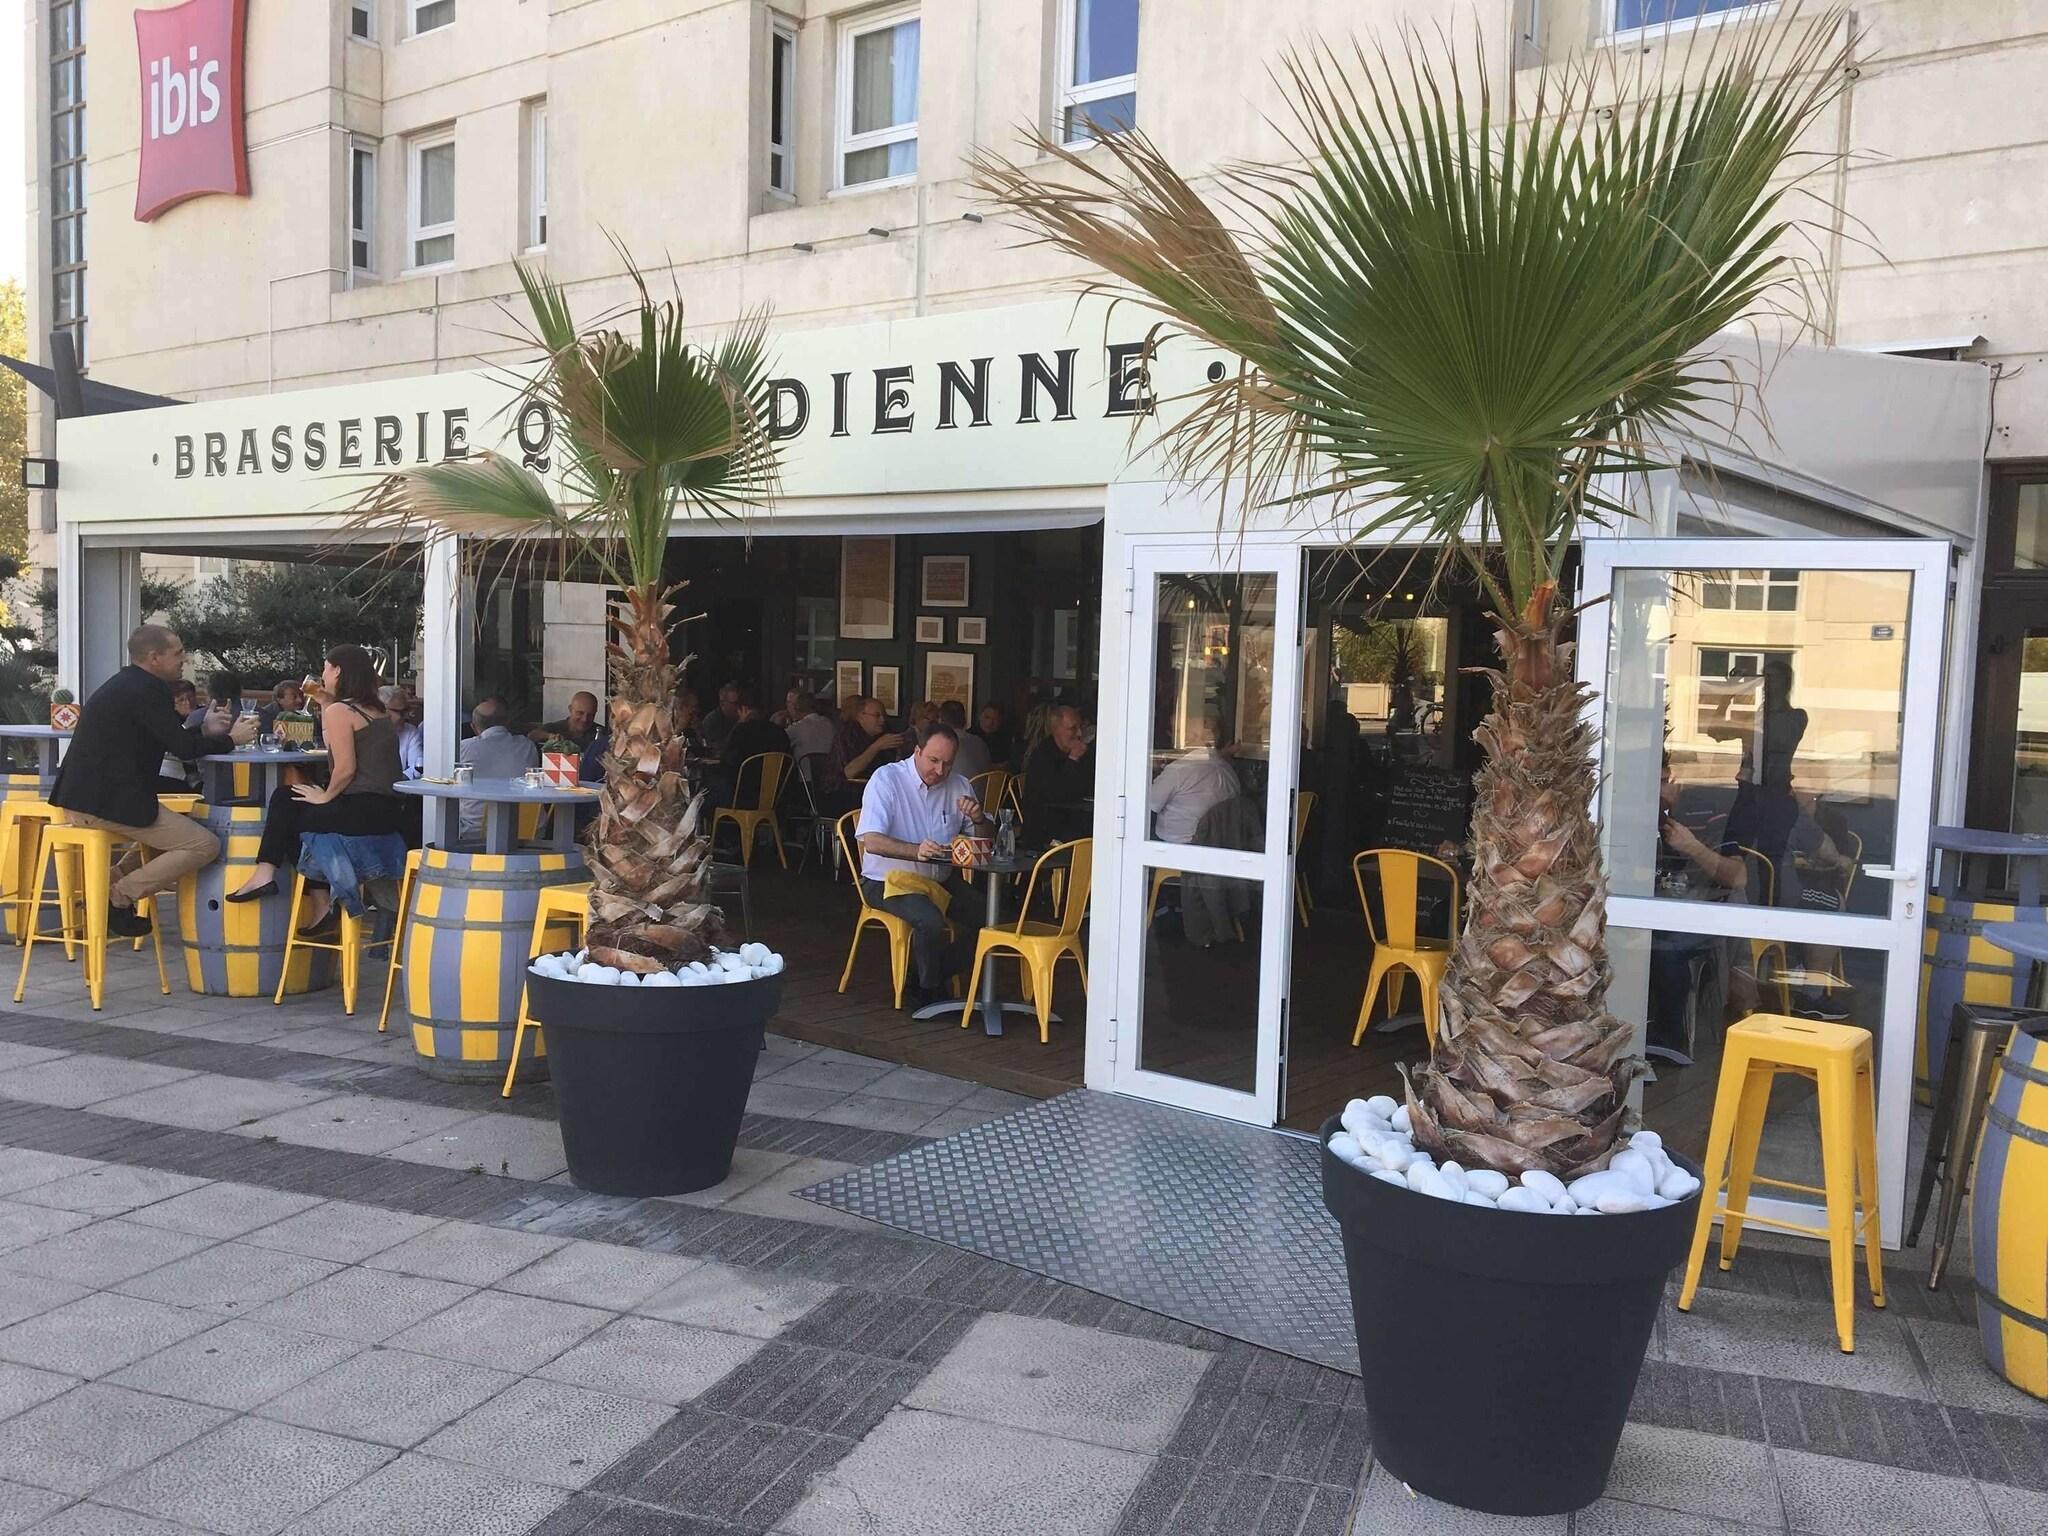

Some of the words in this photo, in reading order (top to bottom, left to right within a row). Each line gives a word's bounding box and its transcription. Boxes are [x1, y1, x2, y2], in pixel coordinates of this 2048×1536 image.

[151, 46, 220, 140] ibis
[174, 407, 471, 480] BRASSERIE
[518, 340, 1158, 474] QDIENNE
